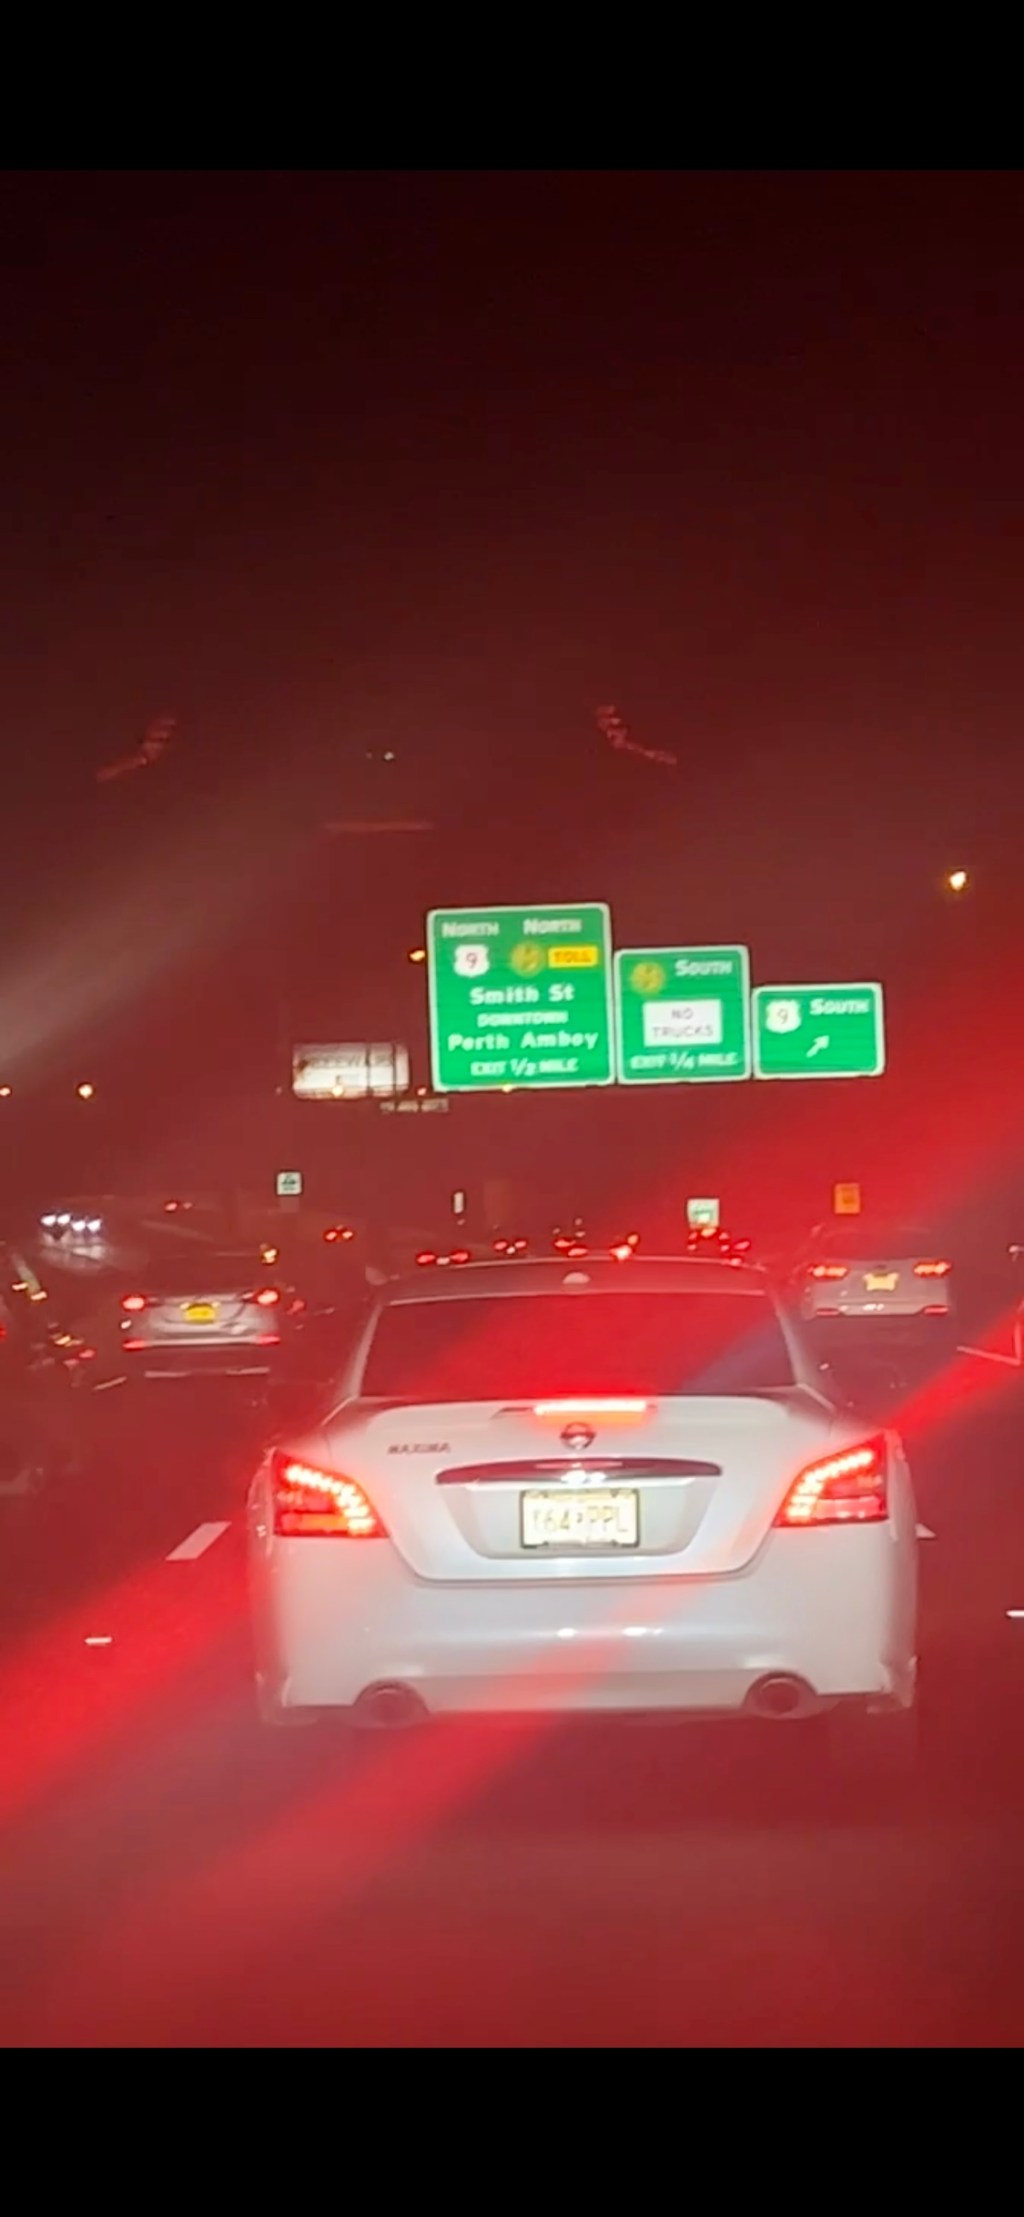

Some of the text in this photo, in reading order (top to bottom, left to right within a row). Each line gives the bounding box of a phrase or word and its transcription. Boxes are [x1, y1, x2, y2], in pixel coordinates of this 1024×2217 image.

[442, 918, 582, 938] NORTH NORTH
[465, 952, 478, 969] 9
[553, 949, 592, 964] TOLL
[674, 960, 732, 976] SOUTH
[469, 983, 575, 1005] Smith St
[477, 1011, 568, 1028] DOWNTOWN
[671, 1007, 694, 1020] NO
[776, 998, 871, 1025] 9 SOUTH
[652, 1025, 714, 1039] TRUCKS
[448, 1031, 598, 1051] Perth Amboy
[470, 1061, 506, 1076] EXIT
[539, 1058, 579, 1073] MILE
[630, 1054, 666, 1069] EXIT
[698, 1052, 738, 1067] MILE
[387, 1442, 452, 1454] MAXIMA
